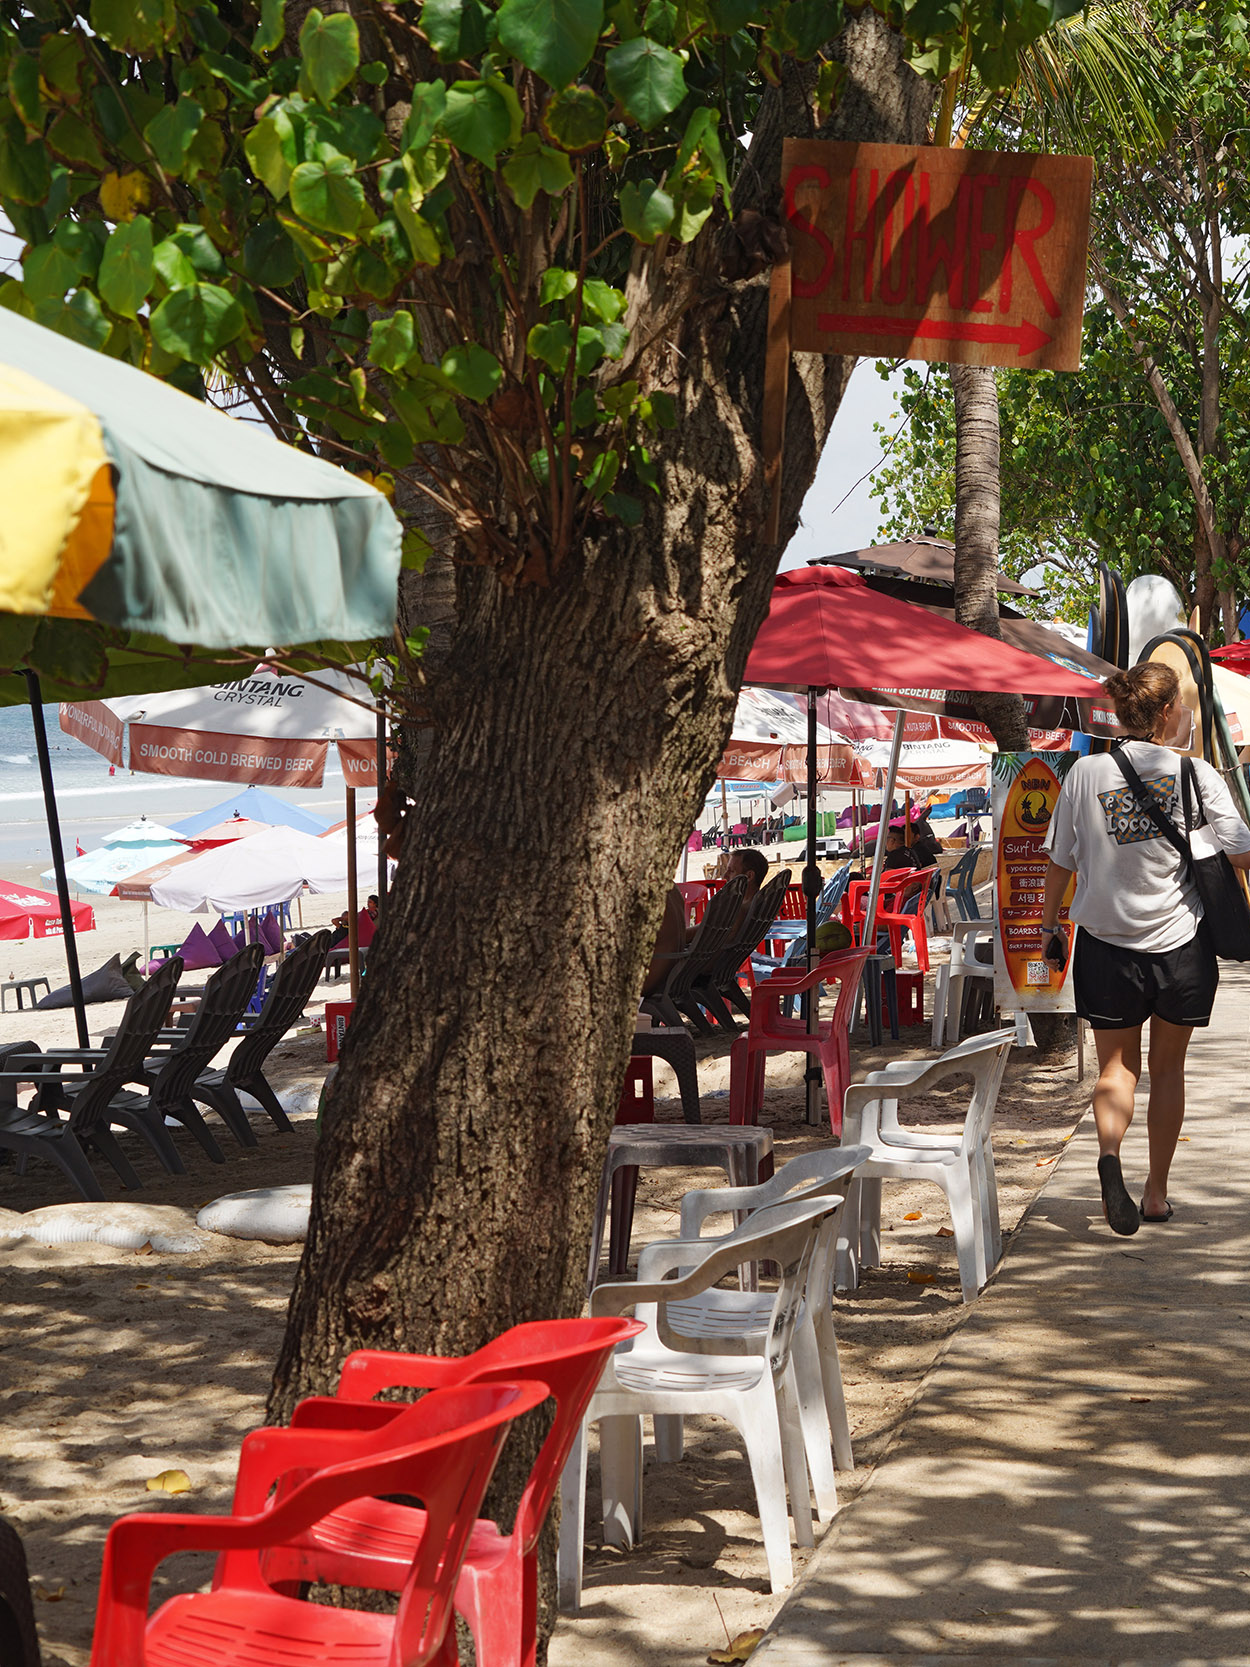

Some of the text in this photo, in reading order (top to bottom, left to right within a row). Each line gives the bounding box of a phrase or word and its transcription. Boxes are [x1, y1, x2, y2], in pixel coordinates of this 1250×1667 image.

[784, 165, 1061, 318] SHOWER
[214, 691, 282, 708] CRYSTAL
[948, 721, 981, 734] SMOOTH
[1045, 731, 1066, 741] BEER
[903, 742, 951, 751] BINTANG
[140, 743, 314, 771] SMOOTH COLD BREWED BEER
[729, 755, 770, 769] BEACH
[935, 773, 954, 782] KUTA
[955, 772, 981, 781] BEACH
[1005, 840, 1030, 857] Surf
[1029, 865, 1048, 873] серф
